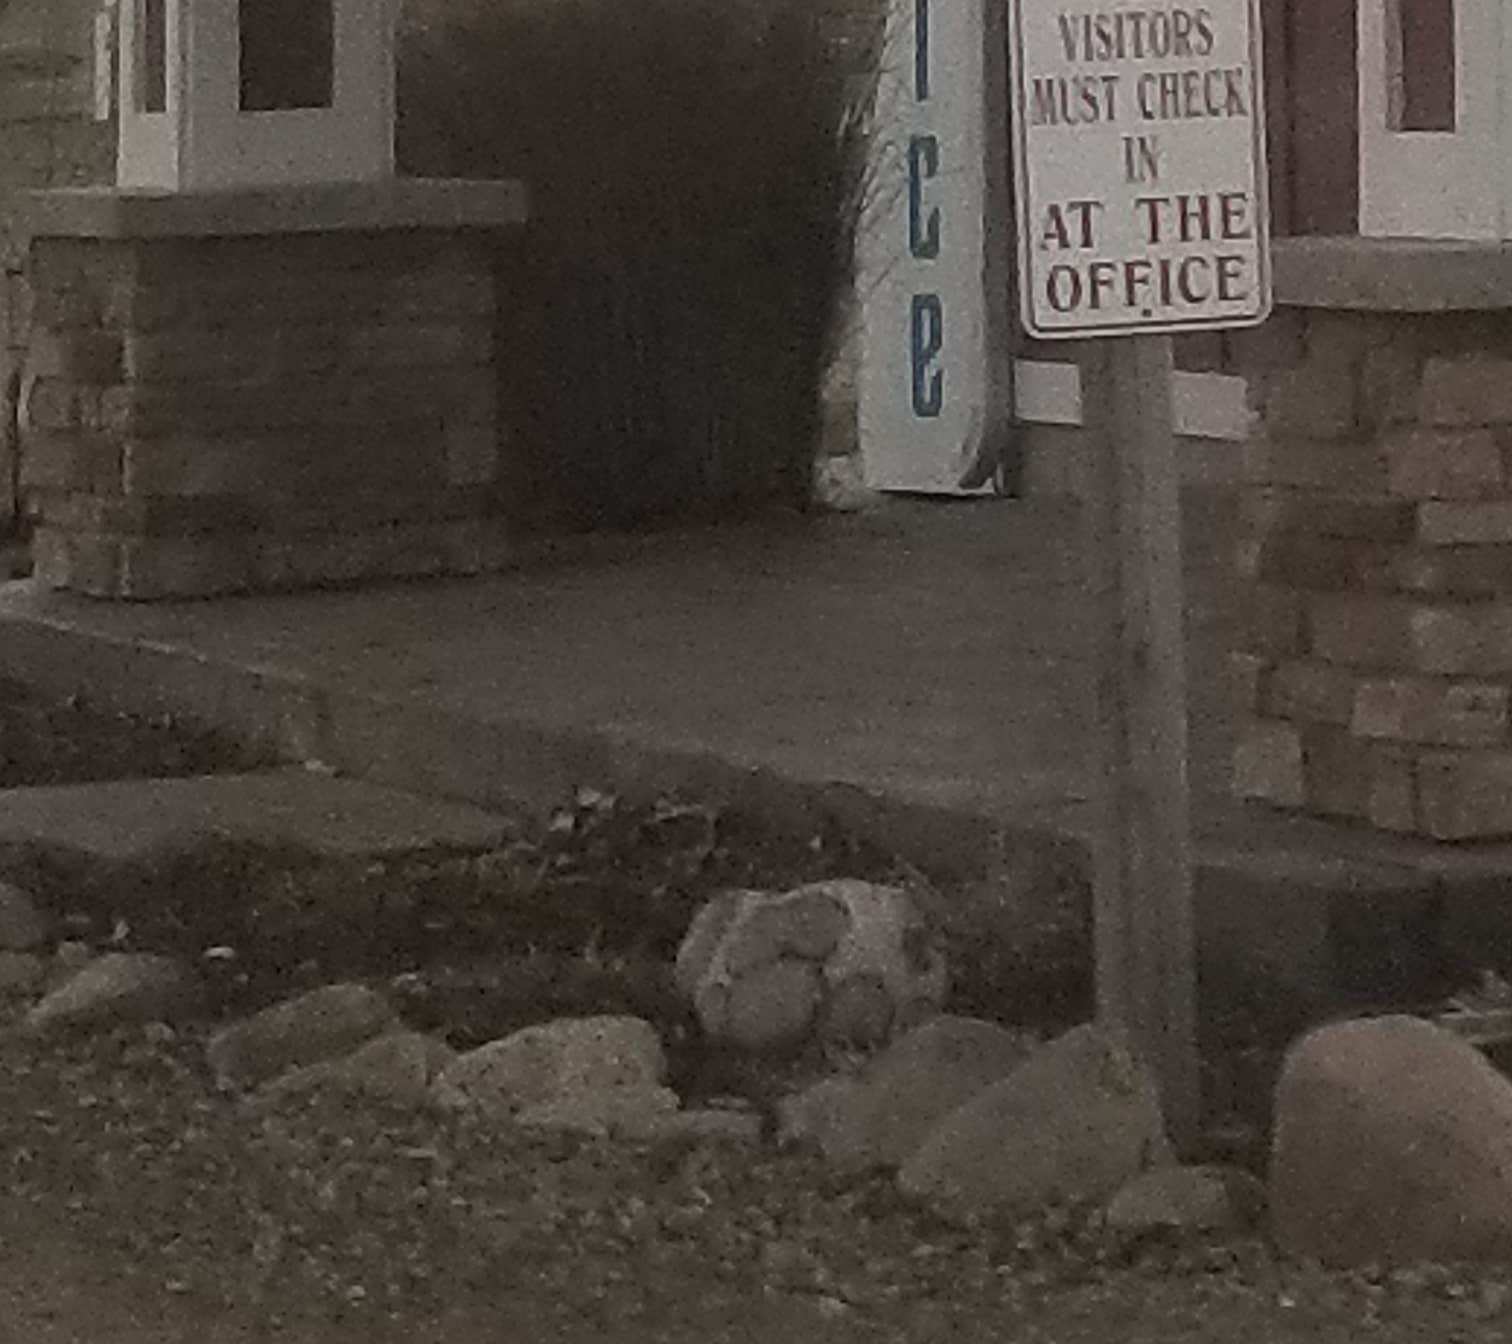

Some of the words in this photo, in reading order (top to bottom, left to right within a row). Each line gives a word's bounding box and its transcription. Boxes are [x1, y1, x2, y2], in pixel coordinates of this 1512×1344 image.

[1058, 8, 1214, 62] VISITORS
[1031, 76, 1120, 126] MUST
[1136, 66, 1248, 120] CHECK
[1120, 135, 1160, 184] IN
[1039, 199, 1104, 250] AT
[1135, 192, 1252, 245] THE
[1046, 255, 1248, 313] OFFICE
